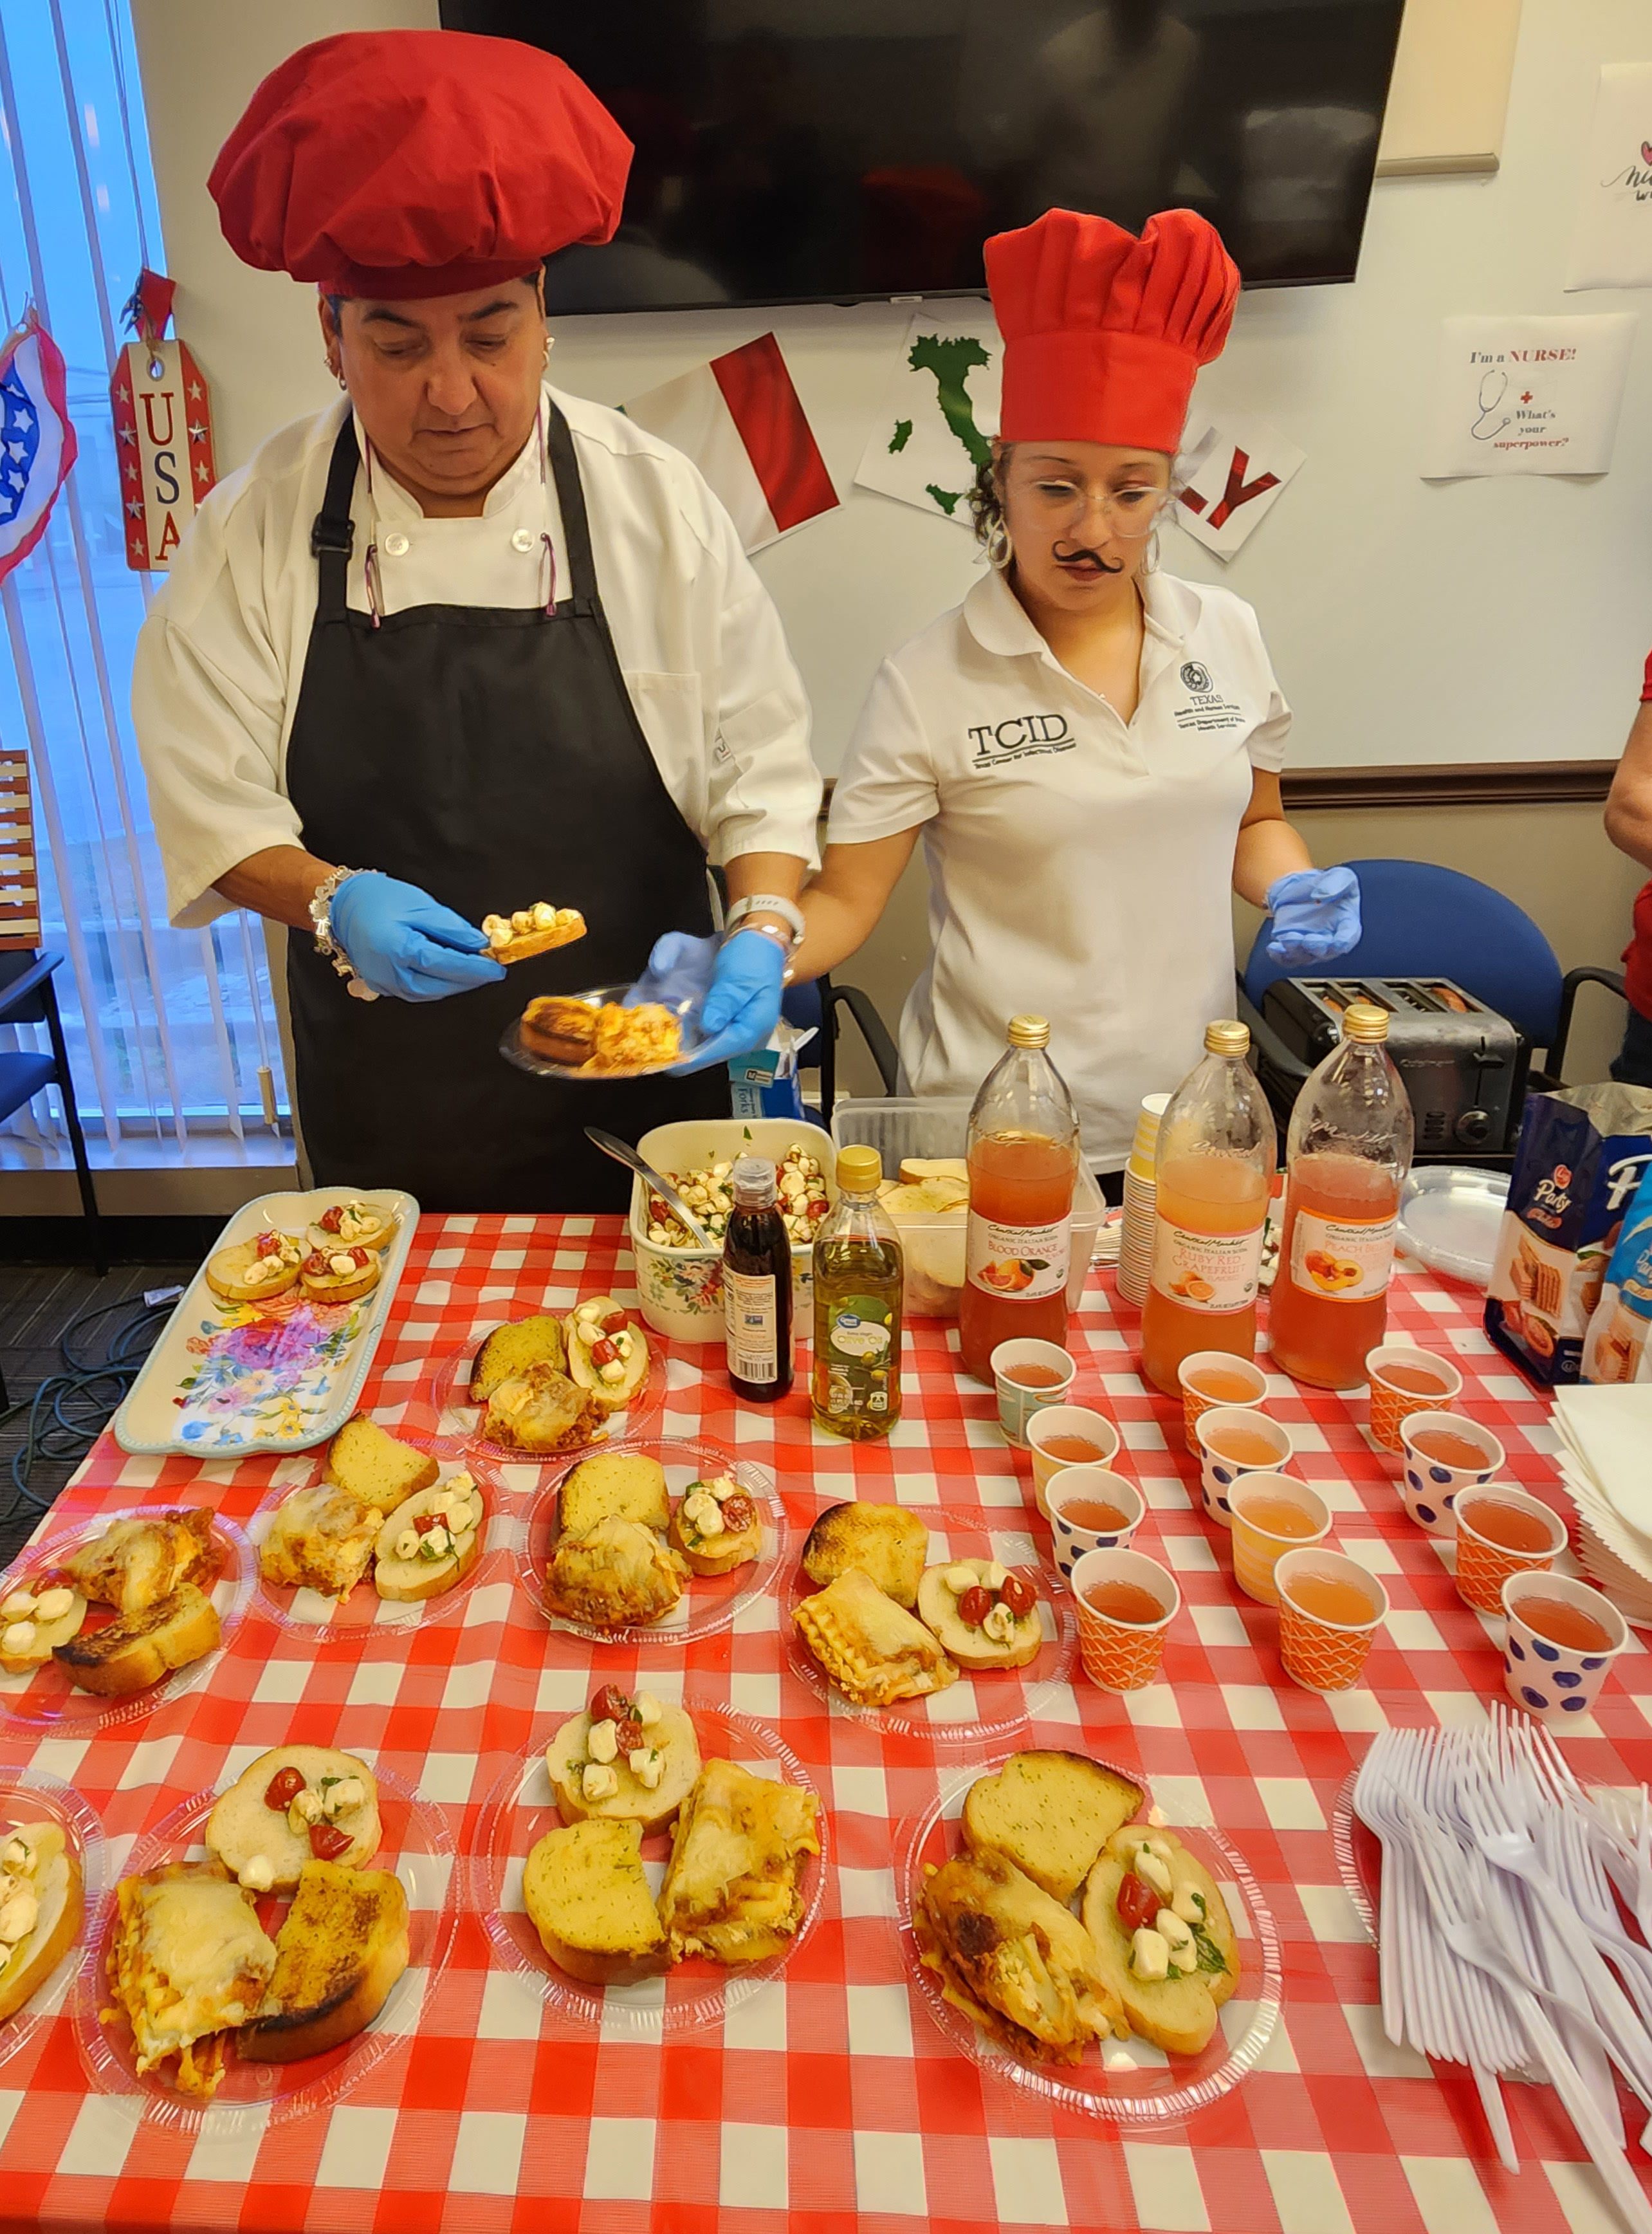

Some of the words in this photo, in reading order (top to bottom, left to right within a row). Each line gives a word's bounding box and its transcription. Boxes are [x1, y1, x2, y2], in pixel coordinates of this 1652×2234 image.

[1470, 352, 1492, 364] I'm
[1509, 348, 1577, 362] NURSE!
[1516, 410, 1556, 420] What's
[1517, 427, 1546, 436] your
[1493, 438, 1569, 450] superpower?
[1179, 445, 1282, 531] Y
[1189, 694, 1224, 705] TEXAS
[968, 714, 1068, 756] TCID
[738, 1089, 750, 1114] Forks
[1533, 1179, 1572, 1214] Party
[988, 1240, 1019, 1256] BLOOD
[1020, 1243, 1058, 1257] ORANGE
[1179, 1248, 1215, 1264] RUBY
[1217, 1255, 1242, 1265] RED
[1172, 1255, 1246, 1275] GRAPEFRUIT
[837, 1335, 865, 1345] Olive
[868, 1336, 883, 1345] Oil
